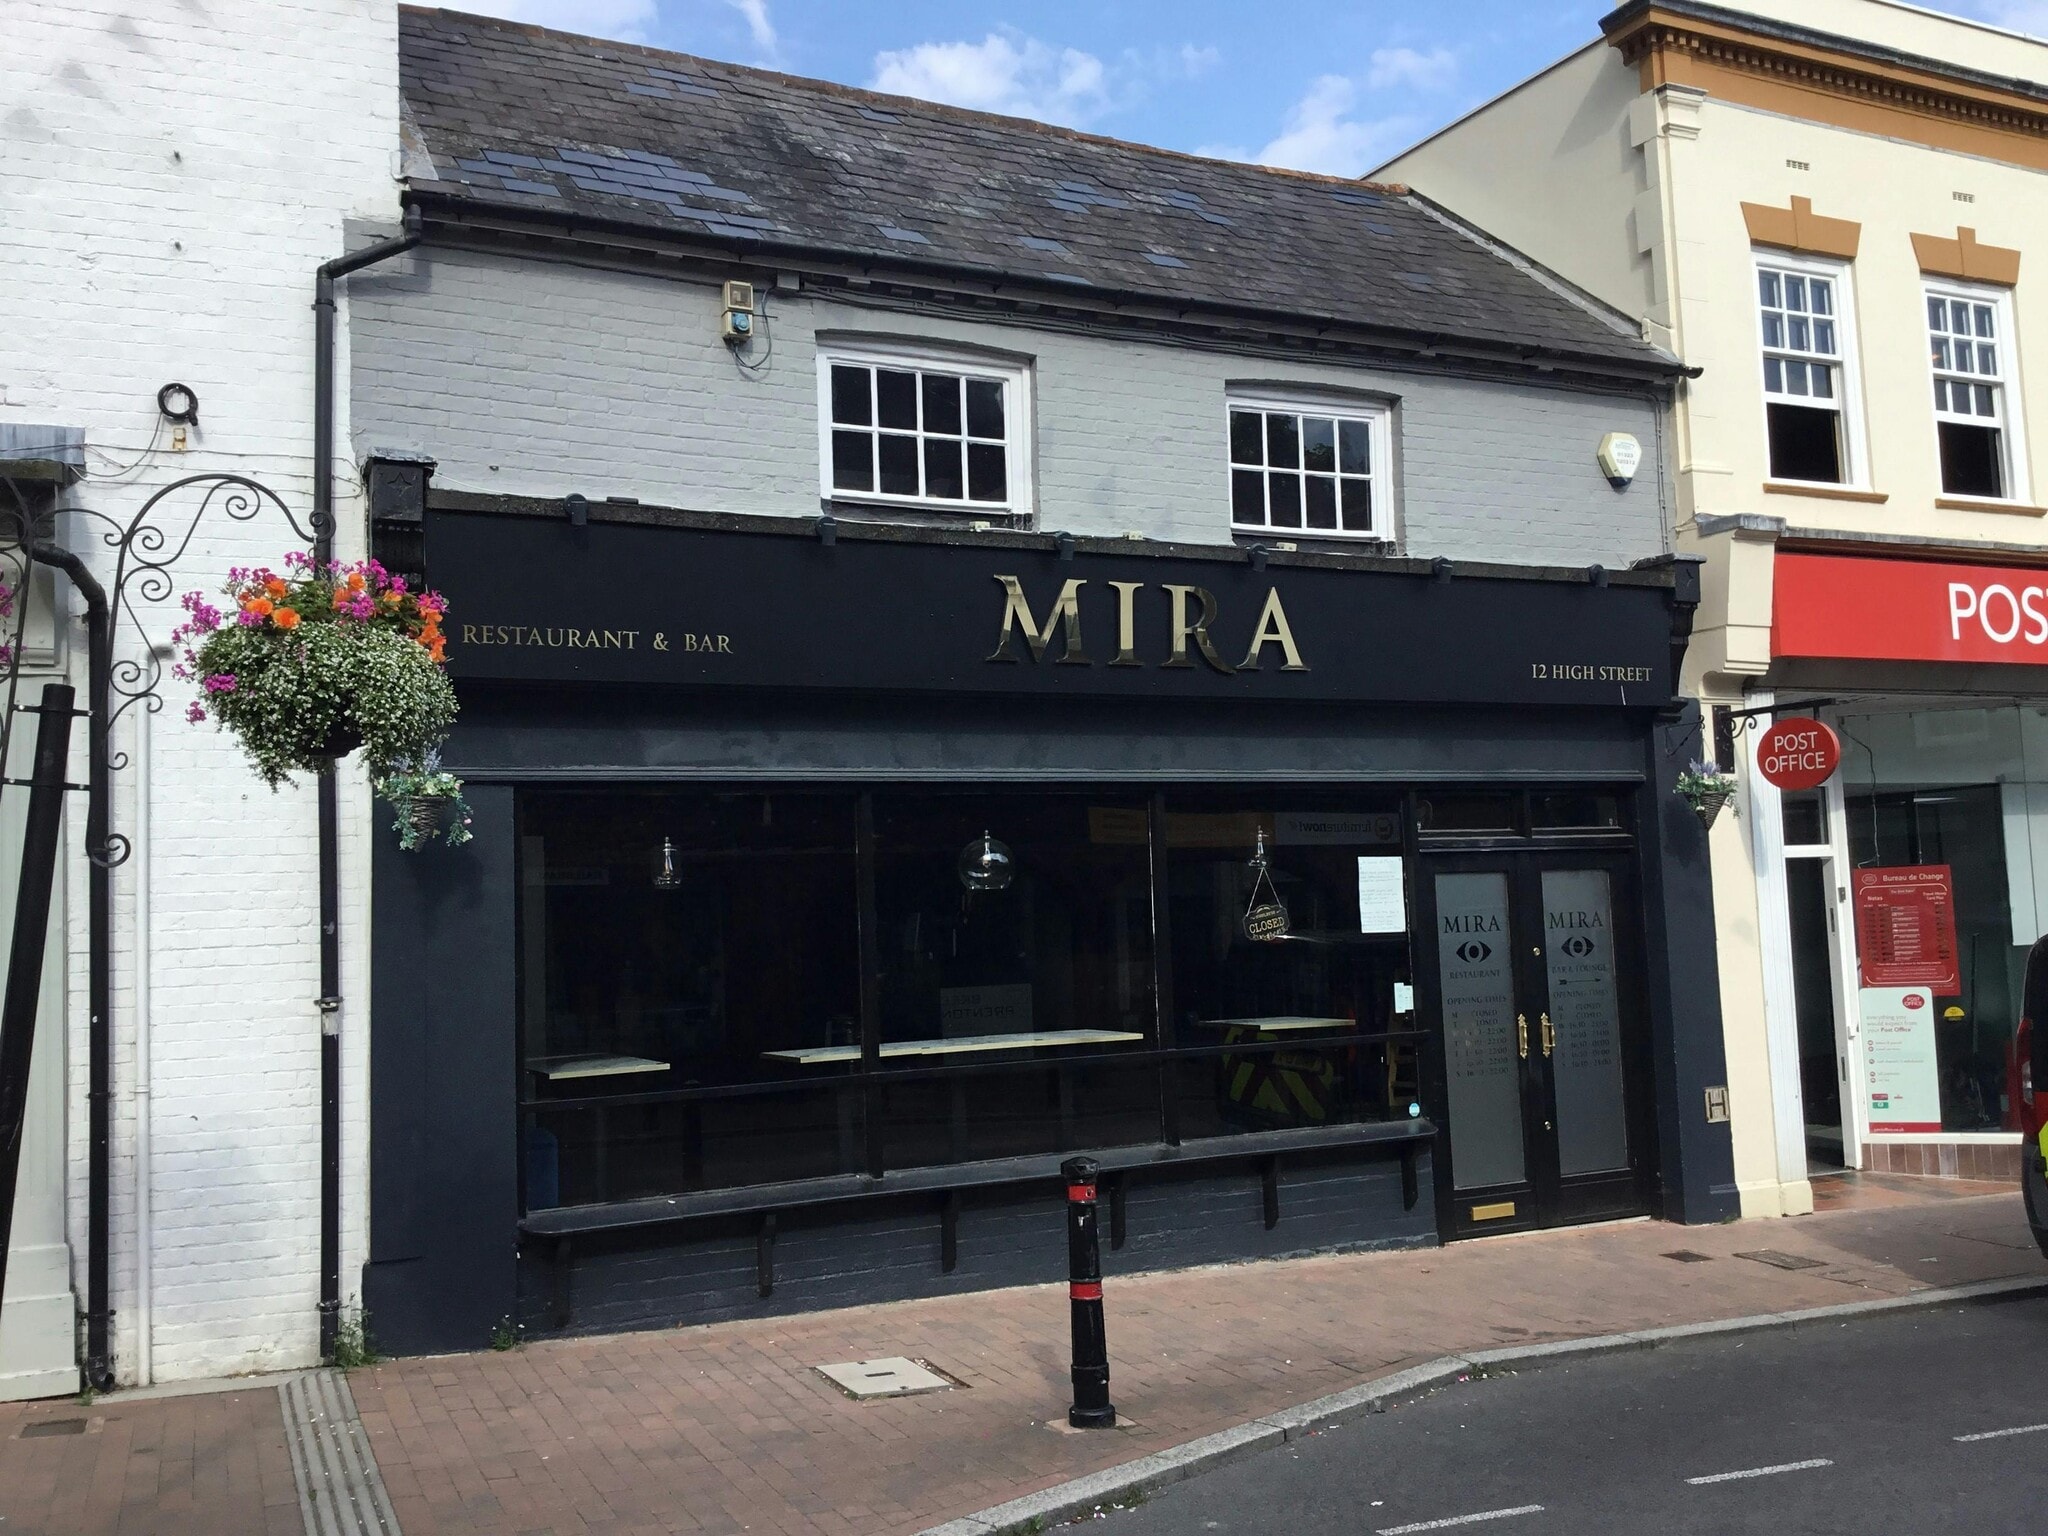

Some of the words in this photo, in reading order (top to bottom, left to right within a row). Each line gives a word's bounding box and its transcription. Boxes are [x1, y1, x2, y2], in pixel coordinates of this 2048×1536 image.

[1948, 582, 2048, 645] POS
[985, 574, 1311, 674] MIRA
[462, 624, 640, 650] RESTAURANT
[653, 632, 670, 651] &
[684, 632, 733, 654] BAR
[1531, 664, 1547, 679] 12
[1552, 664, 1594, 680] HIGH
[1599, 666, 1653, 682] STREET
[1774, 731, 1818, 752] POST
[1765, 751, 1826, 774] OFFICE
[1883, 874, 1907, 882] Bureau
[1908, 873, 1917, 881] de
[1918, 873, 1944, 881] Change
[1249, 916, 1285, 934] CLOSED
[1444, 915, 1501, 934] MIRA
[1549, 911, 1603, 929] MIRA
[1450, 969, 1500, 979] RESTAURANT
[1447, 996, 1481, 1005] OPENING
